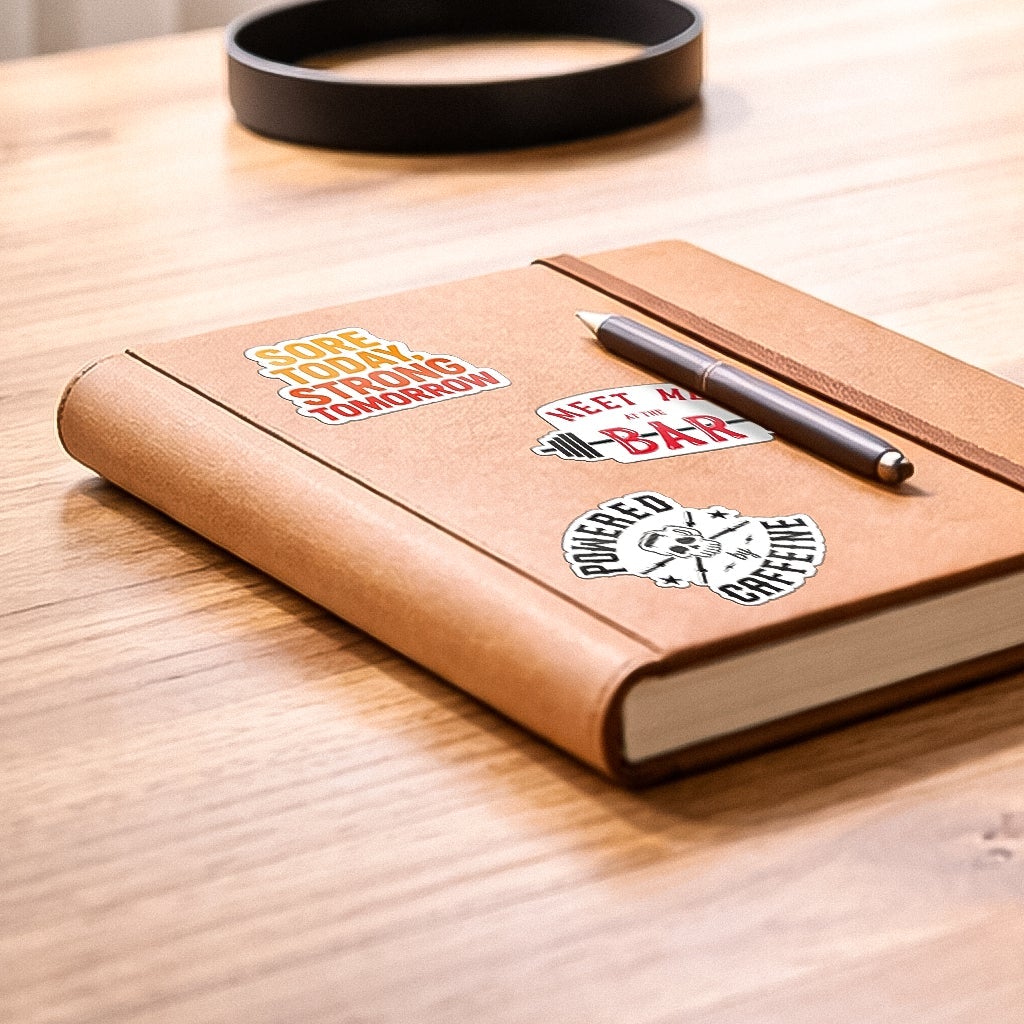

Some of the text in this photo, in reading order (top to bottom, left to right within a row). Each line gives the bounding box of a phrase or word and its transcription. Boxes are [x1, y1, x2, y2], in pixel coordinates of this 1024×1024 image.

[254, 330, 381, 367] SORE
[270, 344, 424, 385] TODAY,
[288, 357, 467, 405] STRONG
[307, 371, 501, 421] TOMORROW
[545, 392, 636, 422] MEET
[640, 409, 667, 417] THE
[598, 414, 748, 455] BAR
[571, 494, 674, 576] POWERED
[718, 517, 817, 603] CAFFEINE
